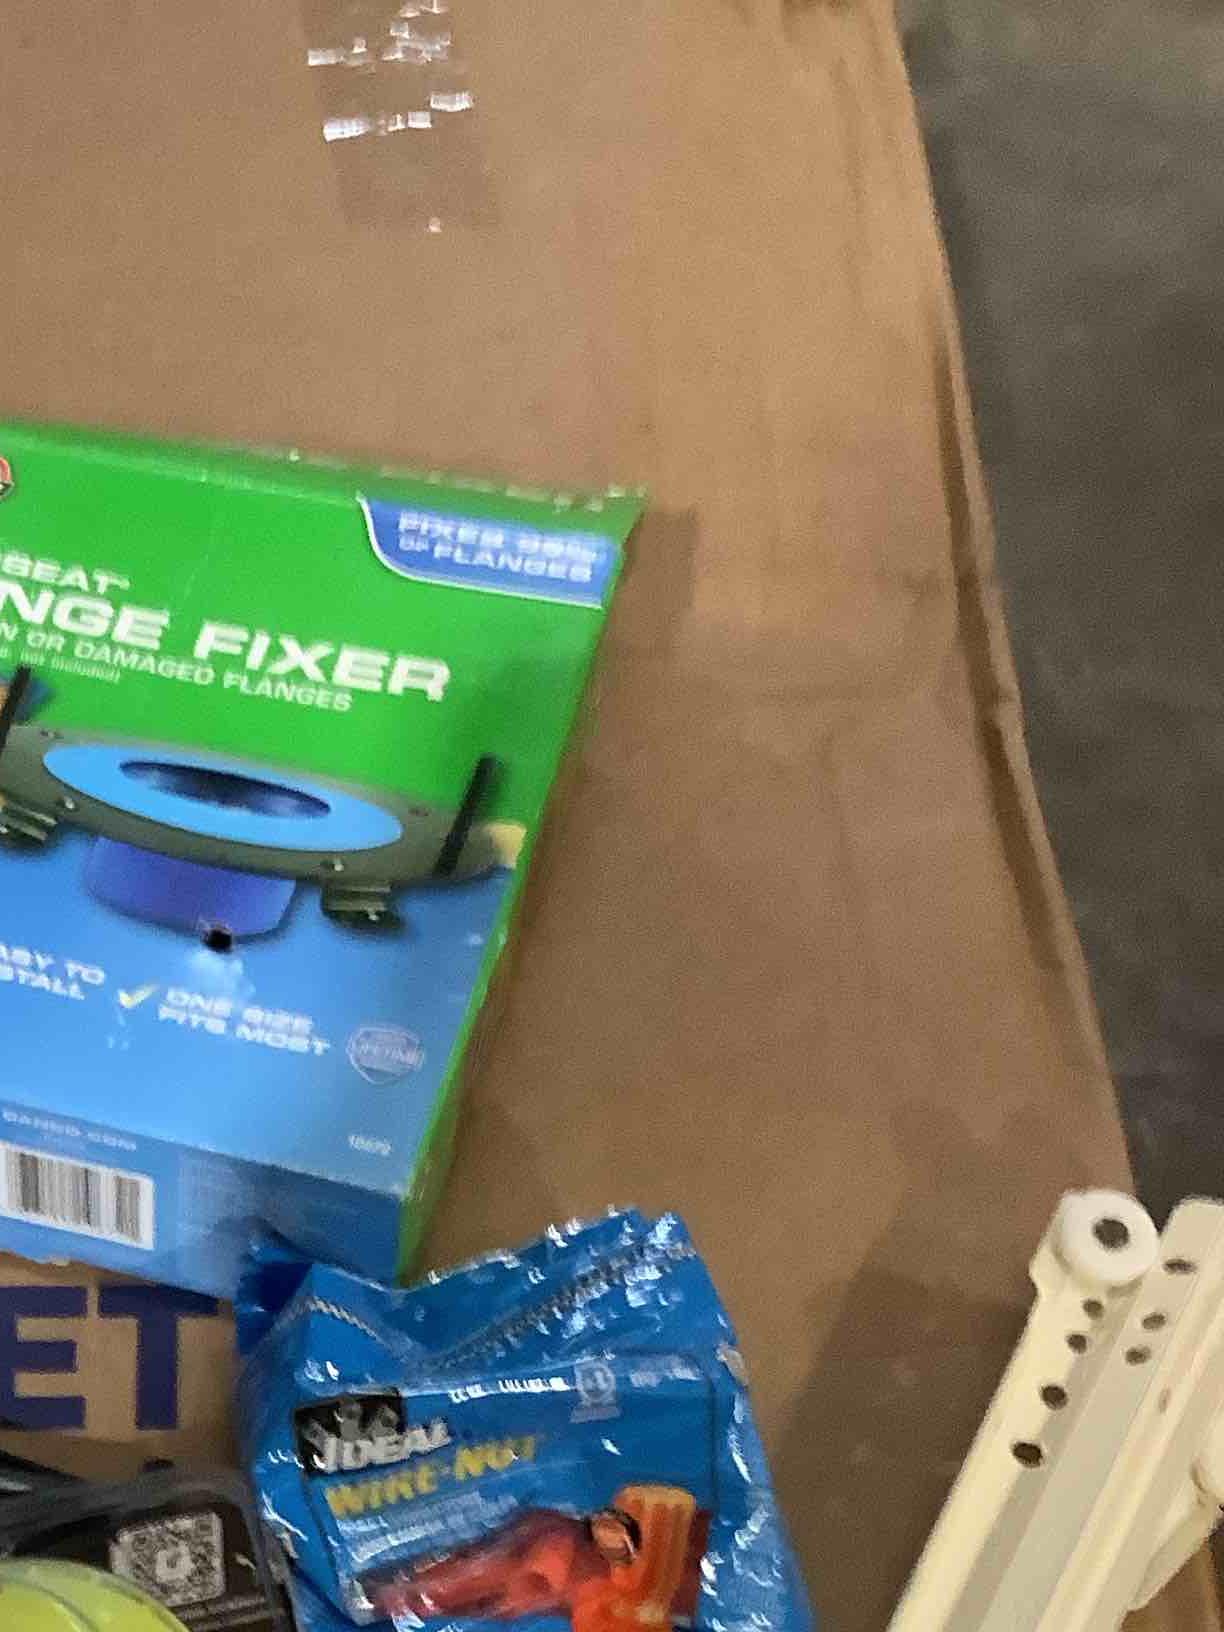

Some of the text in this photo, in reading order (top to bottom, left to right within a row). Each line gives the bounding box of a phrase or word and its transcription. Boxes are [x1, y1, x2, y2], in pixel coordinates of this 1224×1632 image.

[432, 541, 593, 584] FLANGES
[26, 627, 65, 651] OR
[75, 638, 215, 686] DAMAGED
[223, 671, 353, 713] FLANGES
[193, 618, 451, 703] FIXER
[64, 957, 107, 987] TO
[163, 986, 234, 1018] ONE
[157, 1003, 228, 1037] FITS
[234, 1021, 332, 1058] MOST
